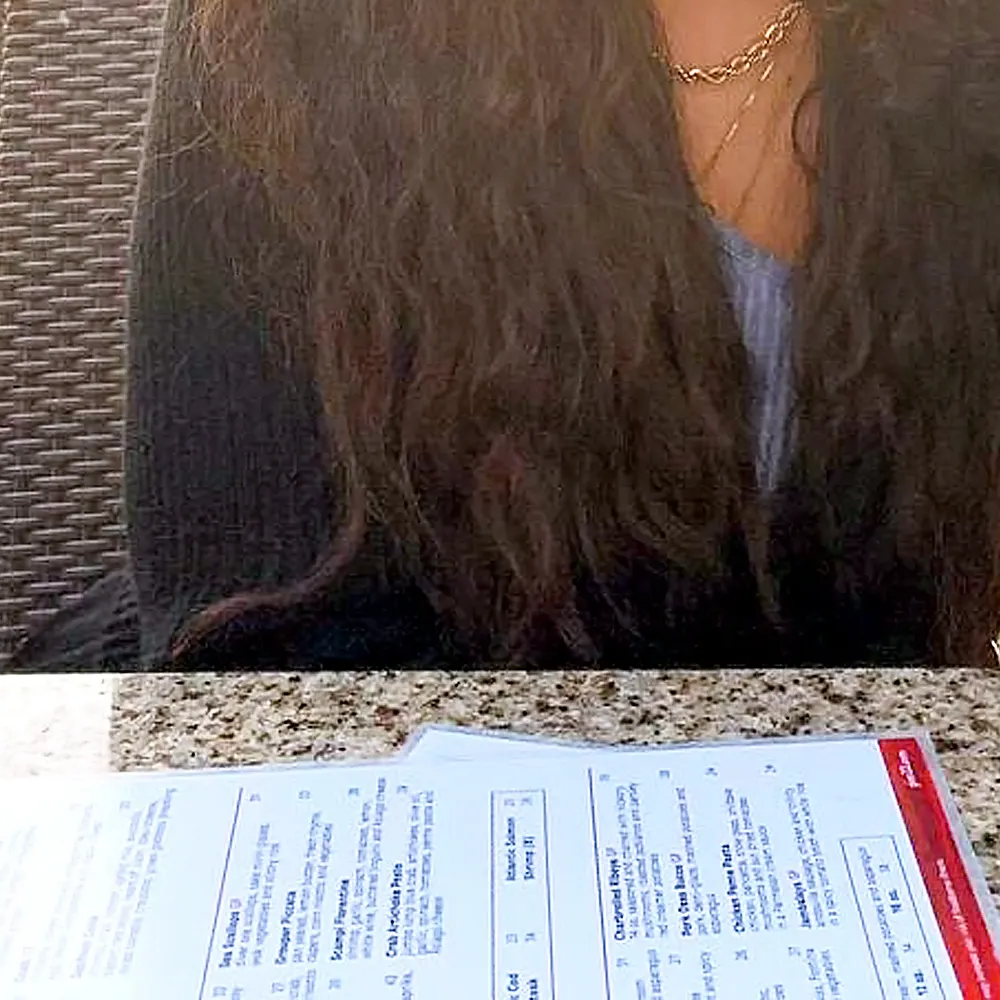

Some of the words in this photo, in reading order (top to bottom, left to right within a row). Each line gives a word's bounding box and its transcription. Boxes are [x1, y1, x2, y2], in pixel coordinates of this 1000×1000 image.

[505, 817, 516, 846] Salmon
[523, 851, 536, 880] Shrimp
[721, 844, 732, 867] Pasta
[608, 859, 621, 886] Ribeye
[727, 870, 738, 895] Penne
[280, 891, 296, 925] Piccata
[334, 880, 349, 925] Florentine
[387, 890, 401, 933] Artichoke
[731, 898, 745, 933] Chicken
[793, 882, 811, 929] Jambalaya
[682, 915, 693, 937] Pork
[330, 927, 346, 960] Scampi
[385, 935, 399, 957] Crab
[507, 973, 519, 992] Cod
